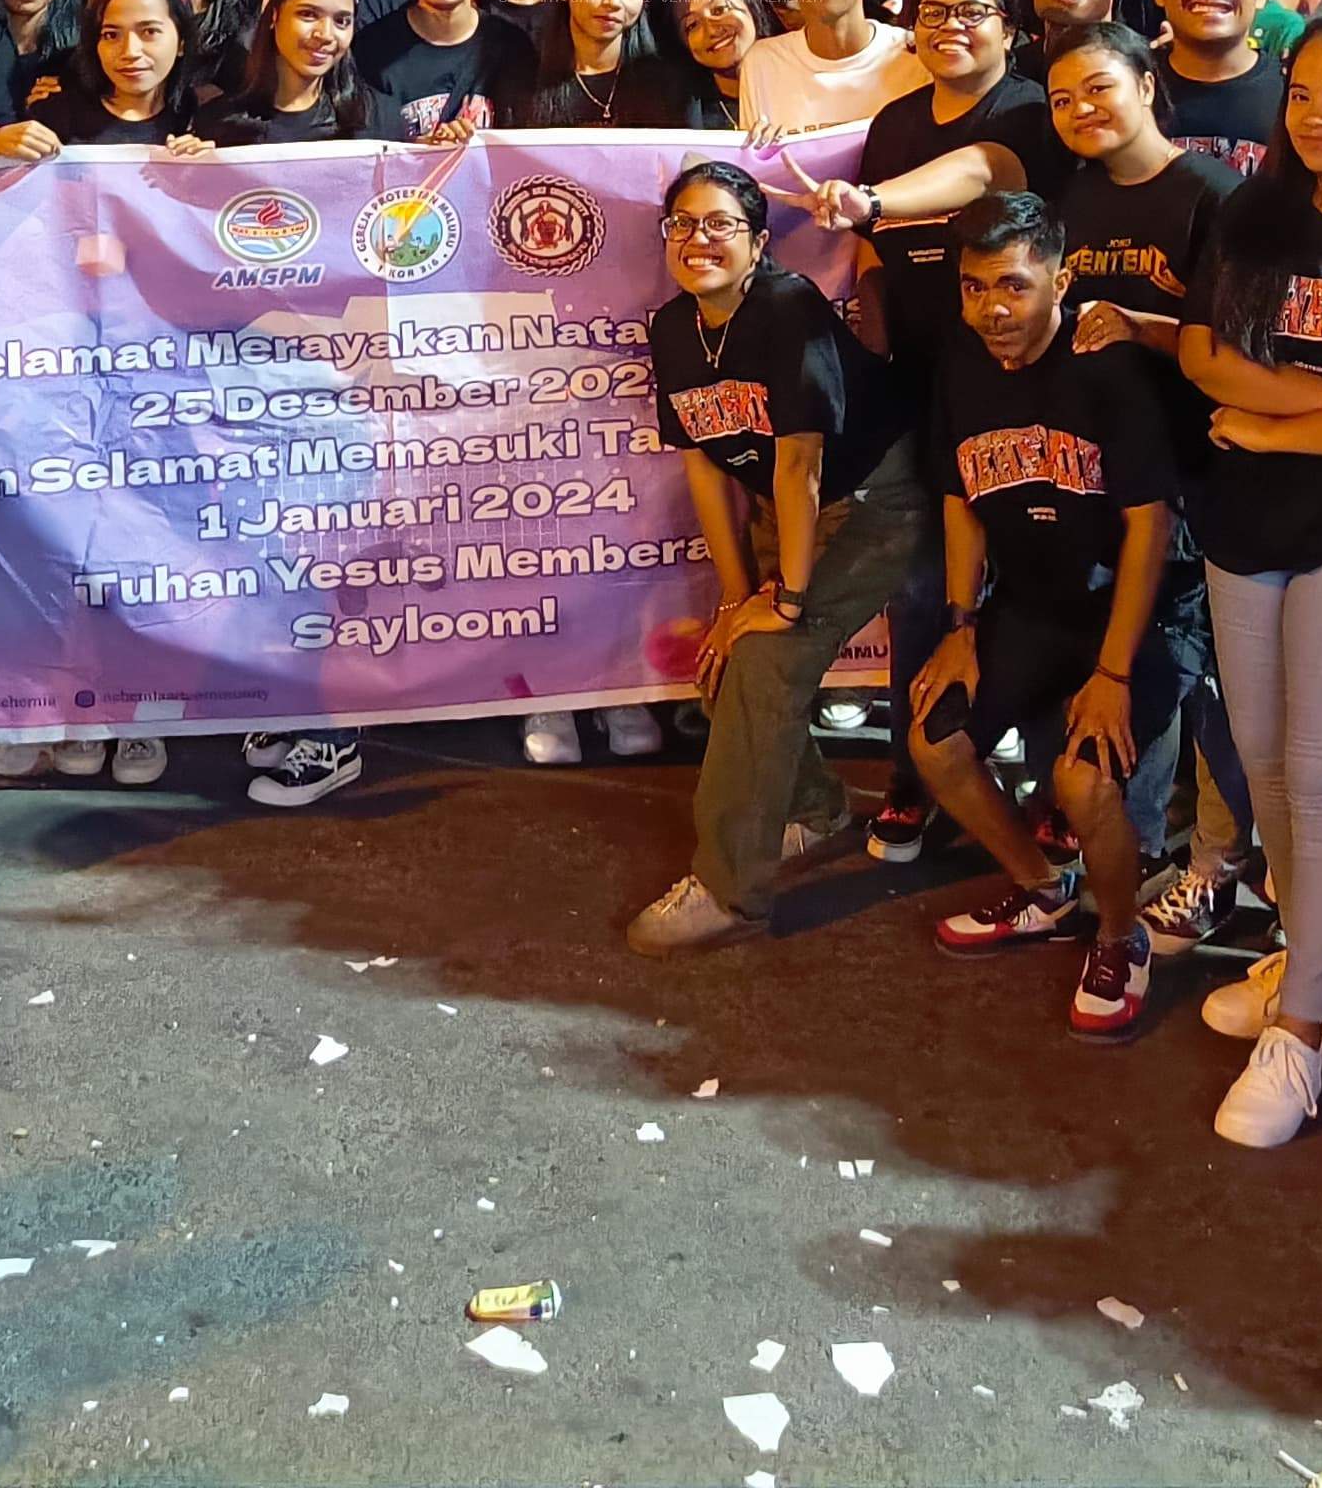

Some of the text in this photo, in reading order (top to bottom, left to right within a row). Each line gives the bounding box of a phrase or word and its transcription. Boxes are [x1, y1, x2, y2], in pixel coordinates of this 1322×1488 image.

[356, 189, 457, 252] GEREJA PROTESTAN MALUKU
[215, 265, 322, 288] AMGPM
[187, 320, 504, 369] Merayakan
[130, 364, 660, 429] 25 Desember 202
[30, 441, 277, 494] Selamat
[289, 420, 580, 475] Memasuki
[589, 422, 676, 456] Ta
[198, 478, 636, 540] 1 Januari 2024
[73, 564, 259, 608] Tuhan
[269, 547, 445, 593] Yesus
[290, 596, 559, 655] Sayloom!
